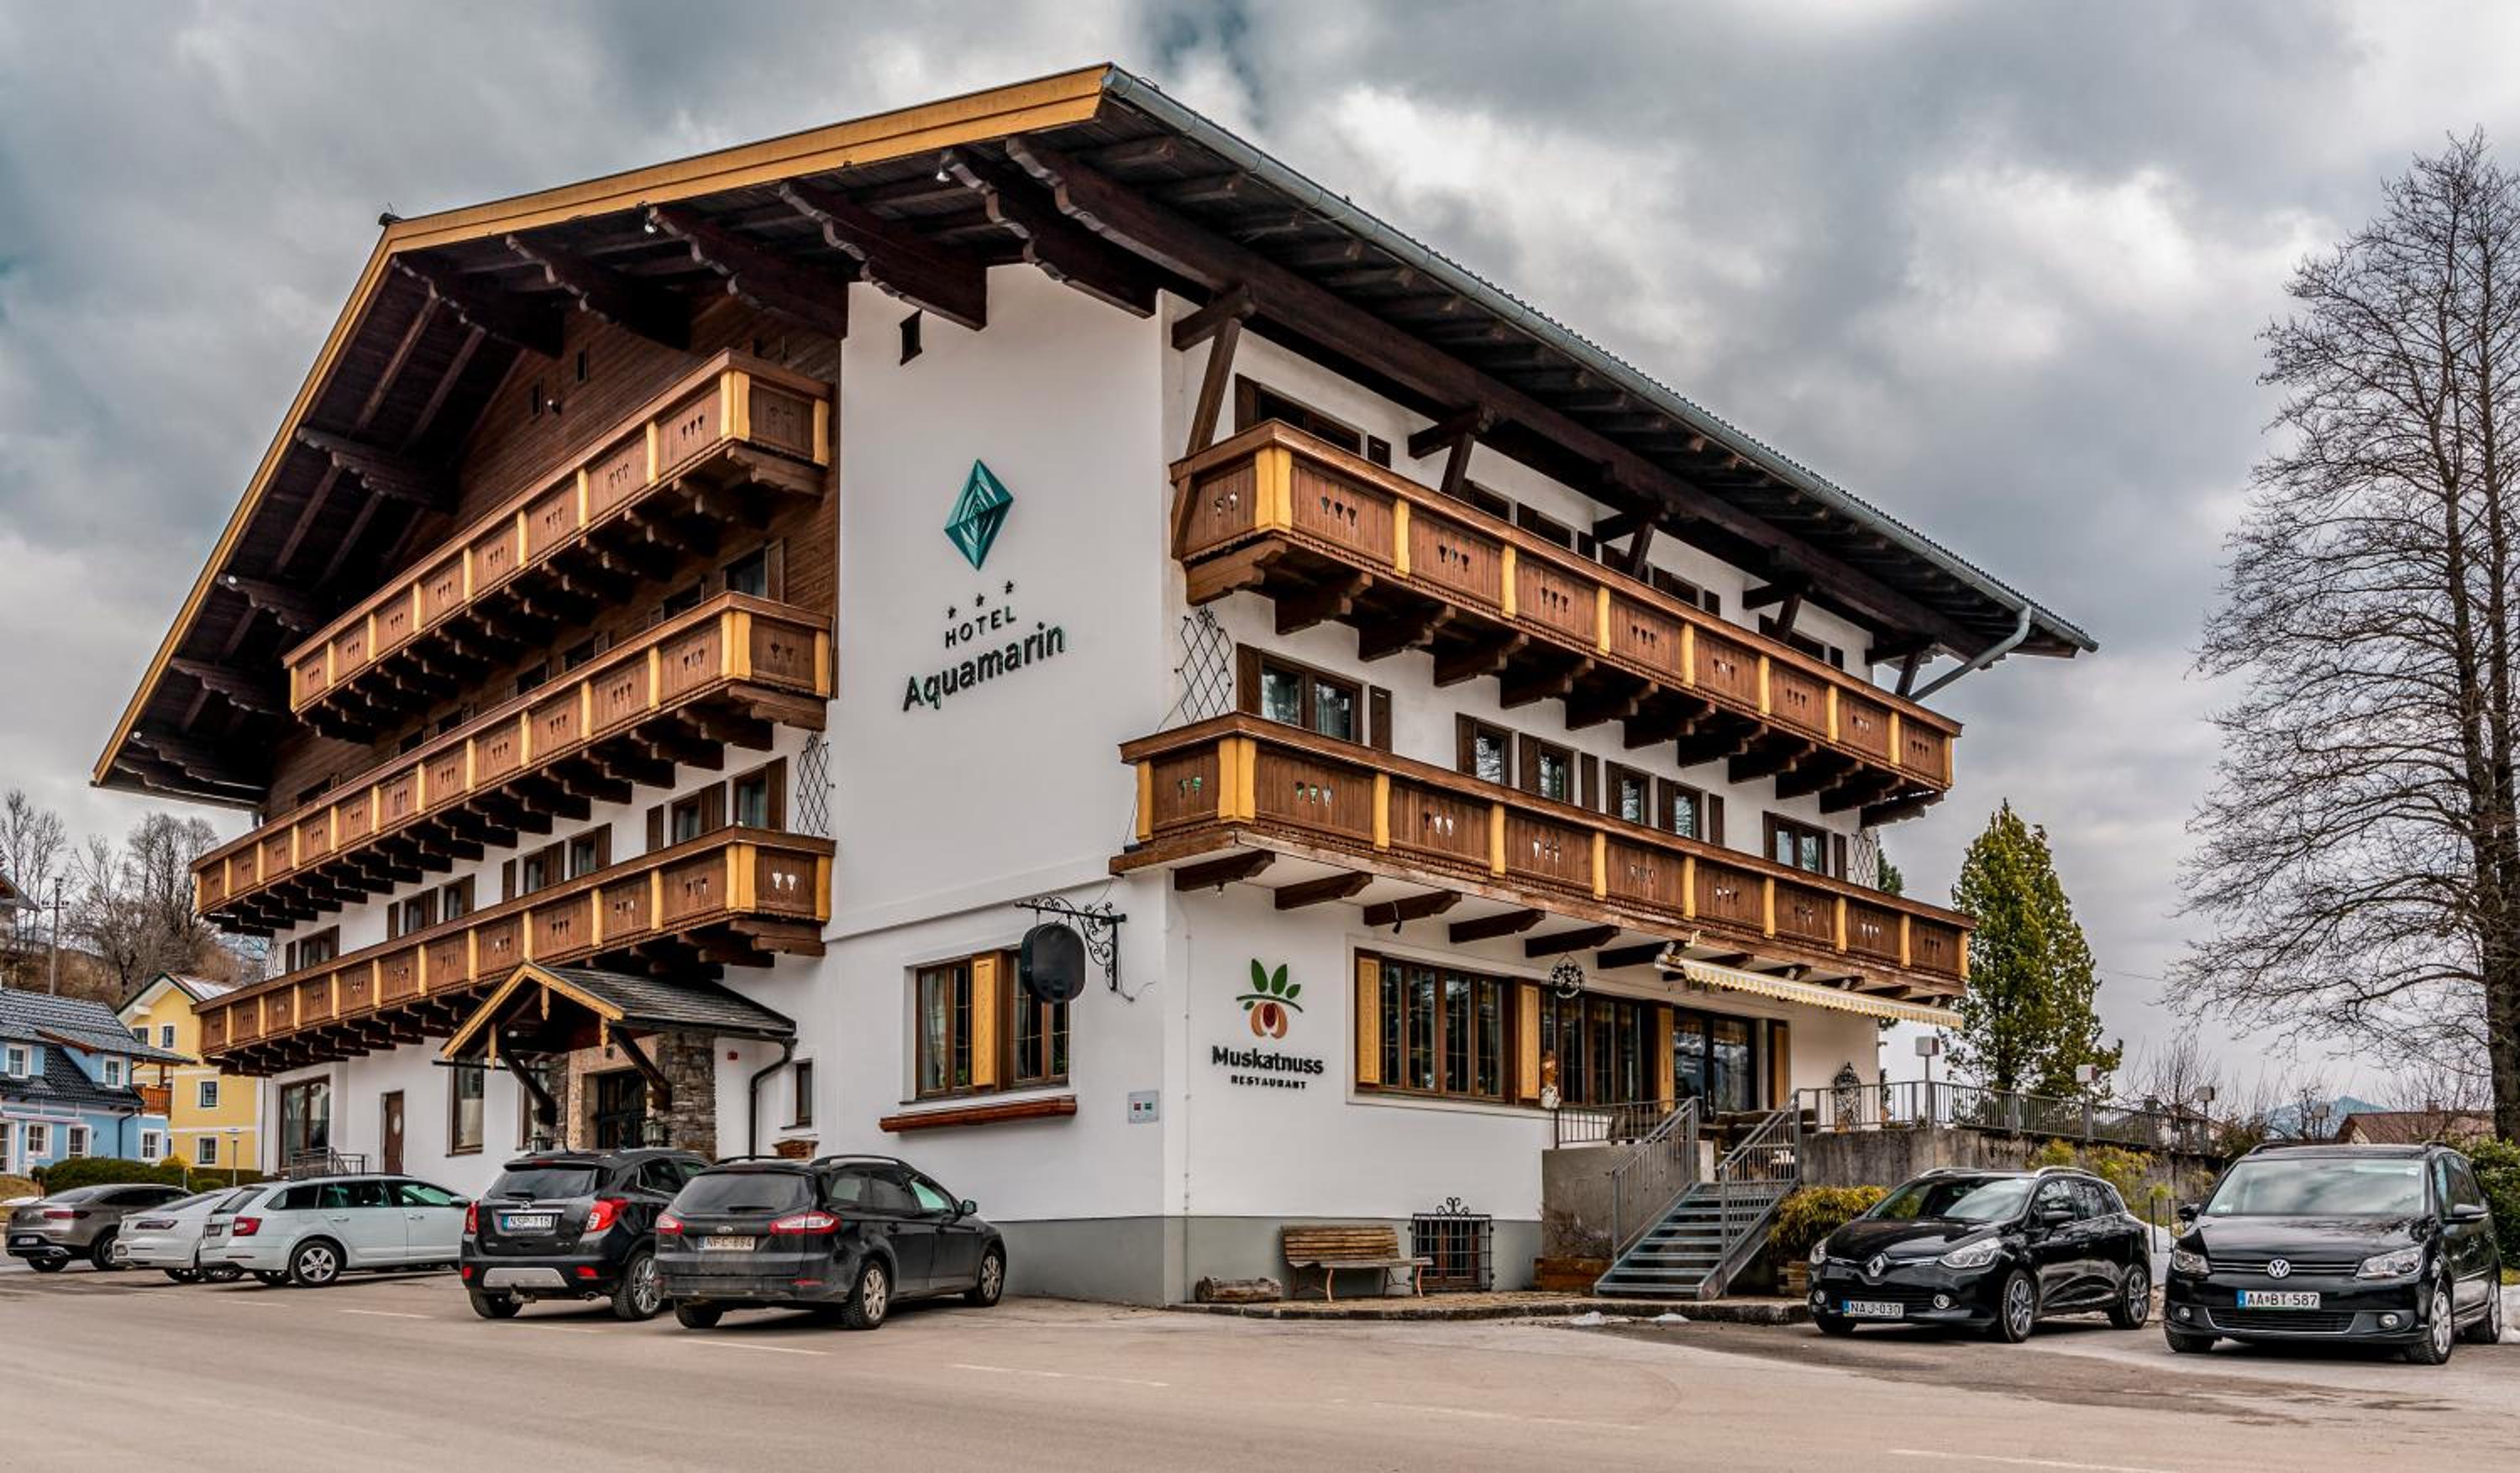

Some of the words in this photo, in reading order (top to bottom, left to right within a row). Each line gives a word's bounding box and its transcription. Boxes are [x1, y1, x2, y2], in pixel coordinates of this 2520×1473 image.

[945, 606, 1016, 648] HOTEL
[903, 621, 1065, 711] Aquamarin
[1212, 1045, 1324, 1075] Muskatnuss
[1231, 1075, 1306, 1090] RESTAURANT
